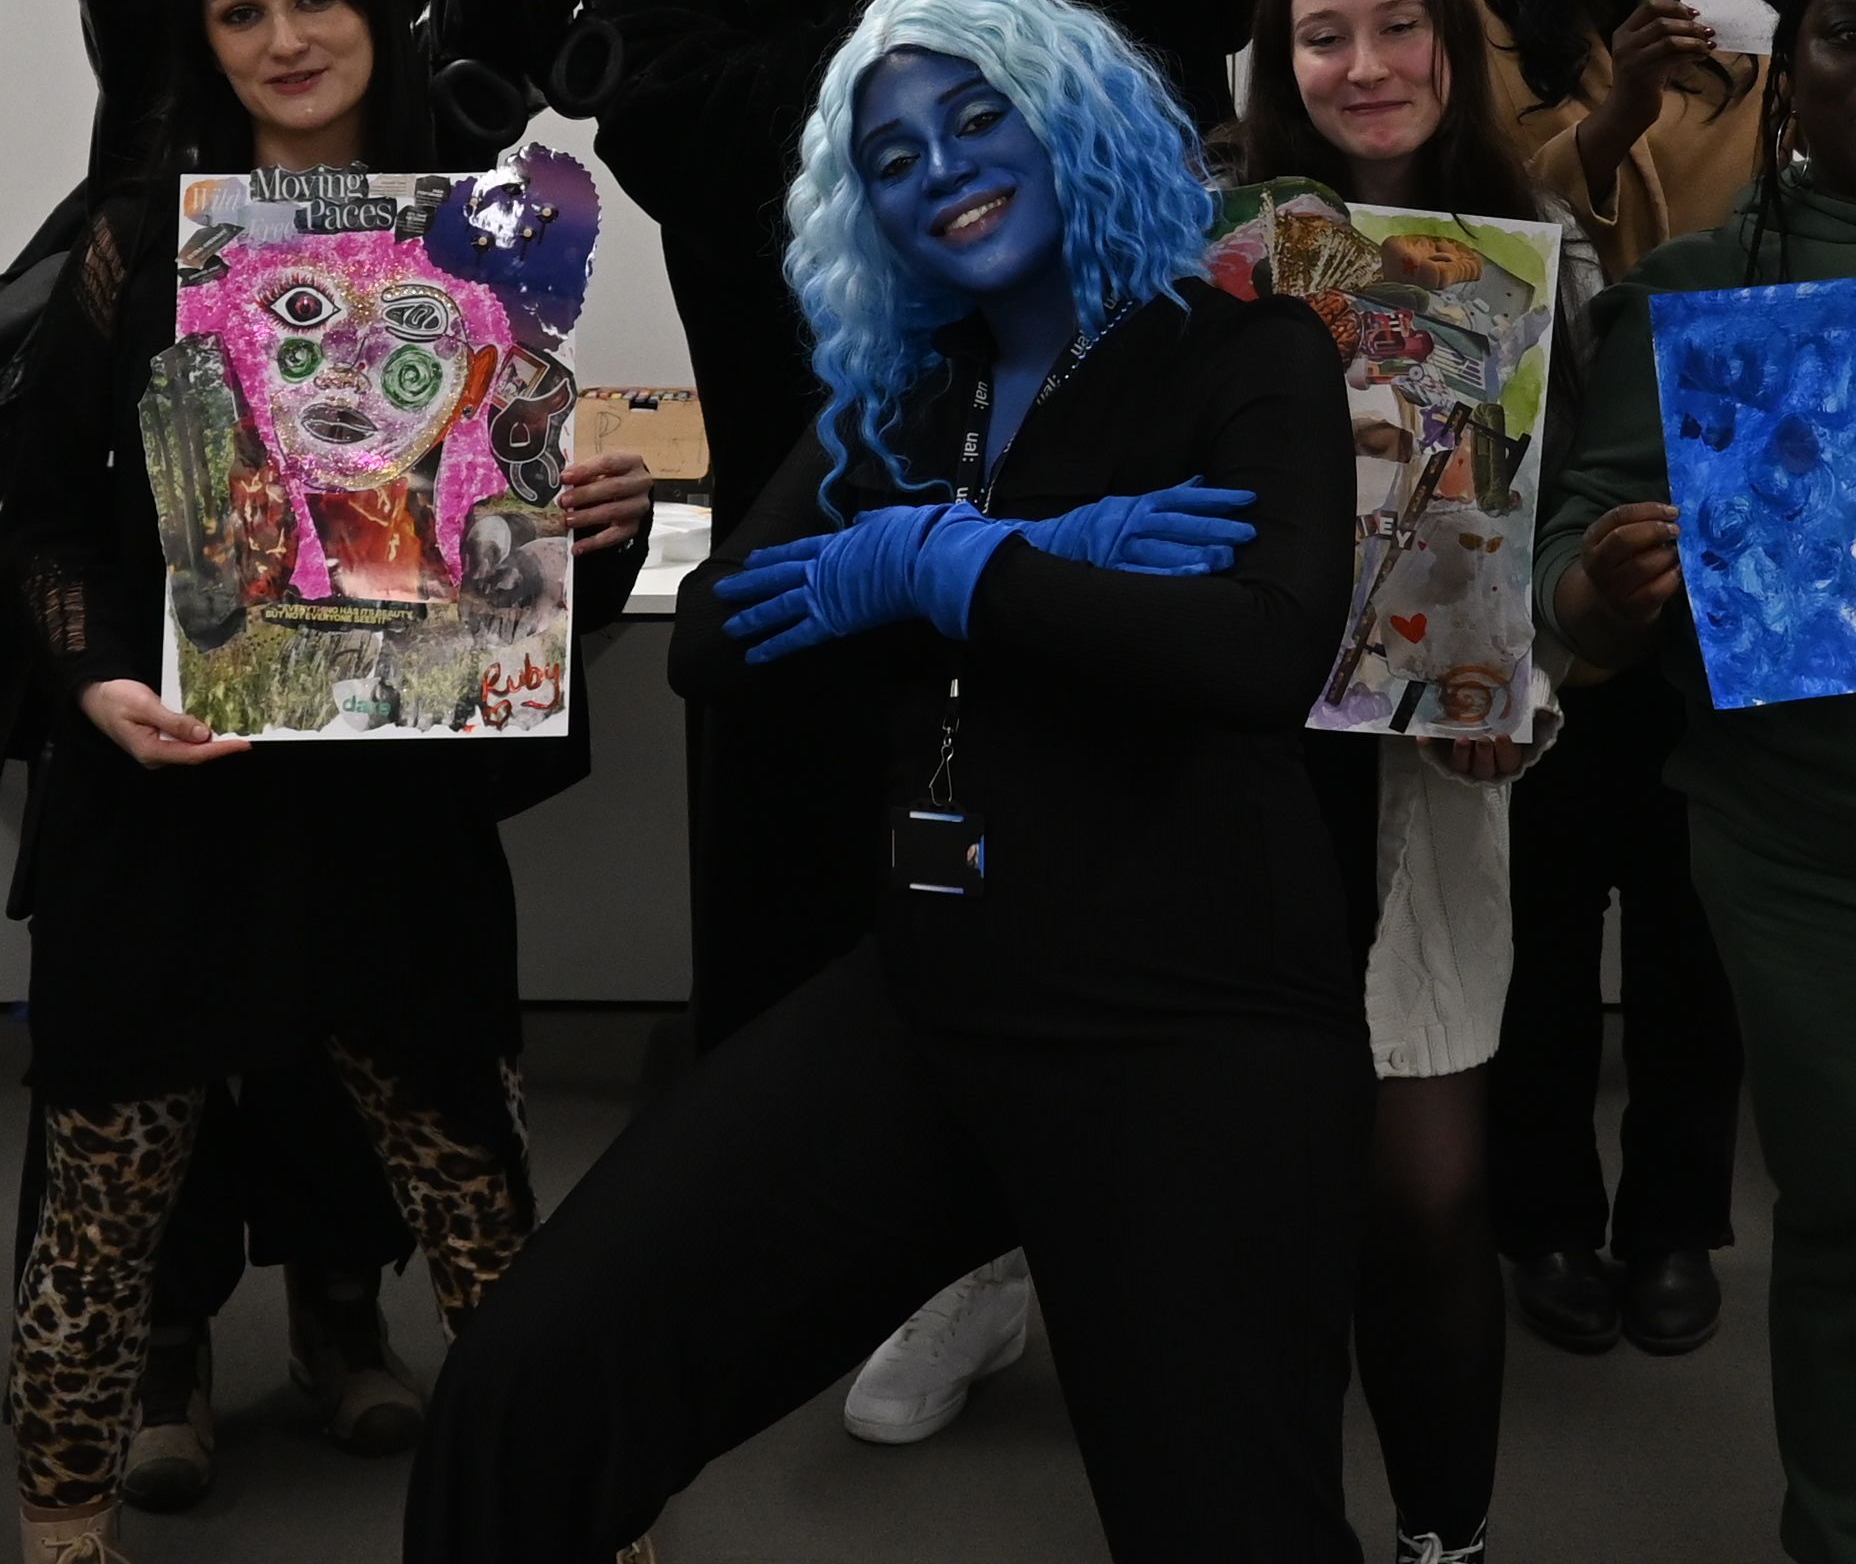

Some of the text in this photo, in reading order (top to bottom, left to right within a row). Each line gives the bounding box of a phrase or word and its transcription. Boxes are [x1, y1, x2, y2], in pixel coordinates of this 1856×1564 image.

[255, 167, 365, 204] Moving
[301, 199, 393, 231] Paces
[481, 652, 561, 710] Ruby
